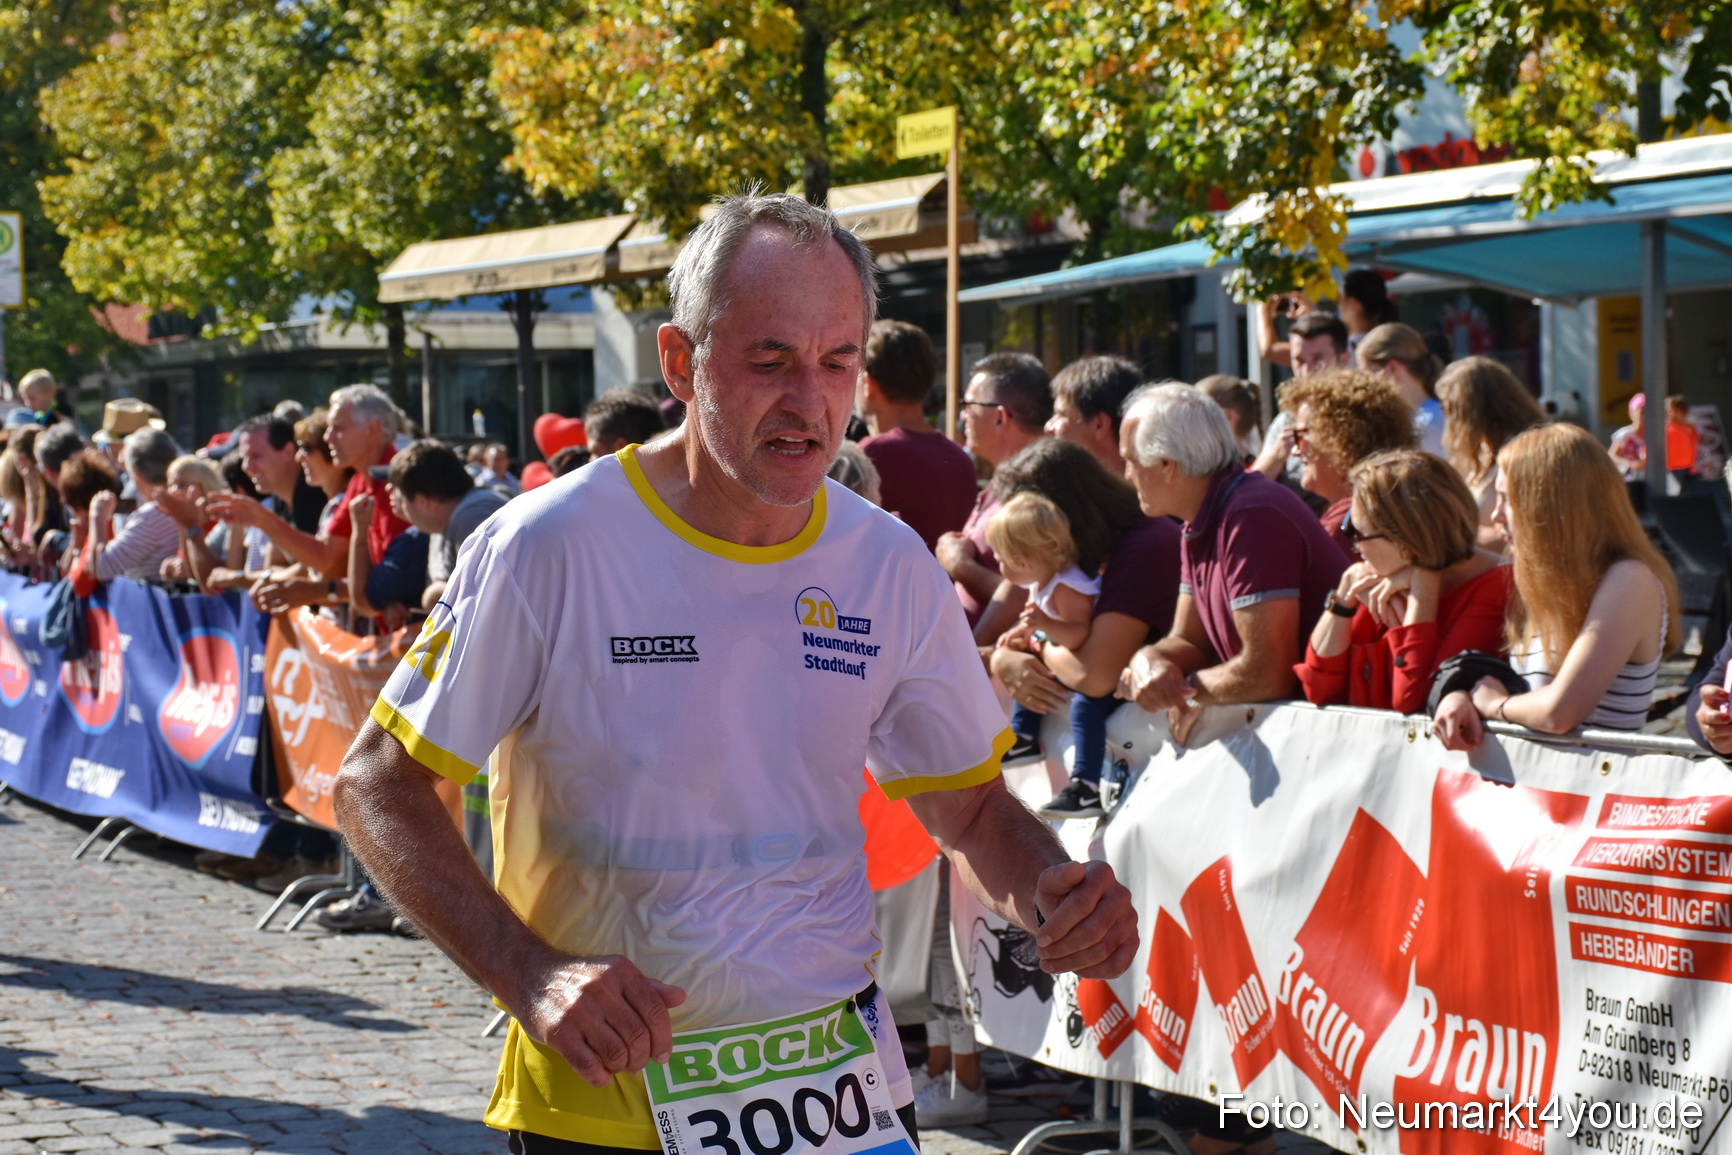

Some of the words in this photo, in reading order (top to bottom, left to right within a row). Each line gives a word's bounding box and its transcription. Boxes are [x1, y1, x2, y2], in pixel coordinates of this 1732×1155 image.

[801, 598, 835, 629] 20
[840, 618, 869, 632] JAHRE
[612, 636, 698, 656] BOCK
[612, 657, 638, 665] inspired
[639, 657, 648, 665] by
[670, 656, 700, 664] concepts
[803, 632, 881, 657] Neumarkter
[804, 653, 866, 680] Stadtlauf
[1608, 802, 1711, 826] BINDESTRICKE
[1575, 885, 1731, 927] RUNDSCHLINGEN
[1580, 931, 1694, 973] HEBEBÄNDER
[1138, 973, 1186, 1046] Braun
[1214, 973, 1267, 1048] Braun
[1276, 939, 1365, 1081] Braun
[1587, 988, 1622, 1018] Braun
[1626, 997, 1674, 1028] GmbH
[664, 1008, 859, 1093] BOCK
[1397, 984, 1546, 1107] Braun
[1583, 1019, 1601, 1045] Am
[1605, 1024, 1676, 1065] Grünberg
[1682, 1038, 1691, 1062] 8
[1578, 1049, 1633, 1083] D-92318
[1638, 1061, 1732, 1103] Neumarkt-Pö
[687, 1072, 871, 1155] 3000
